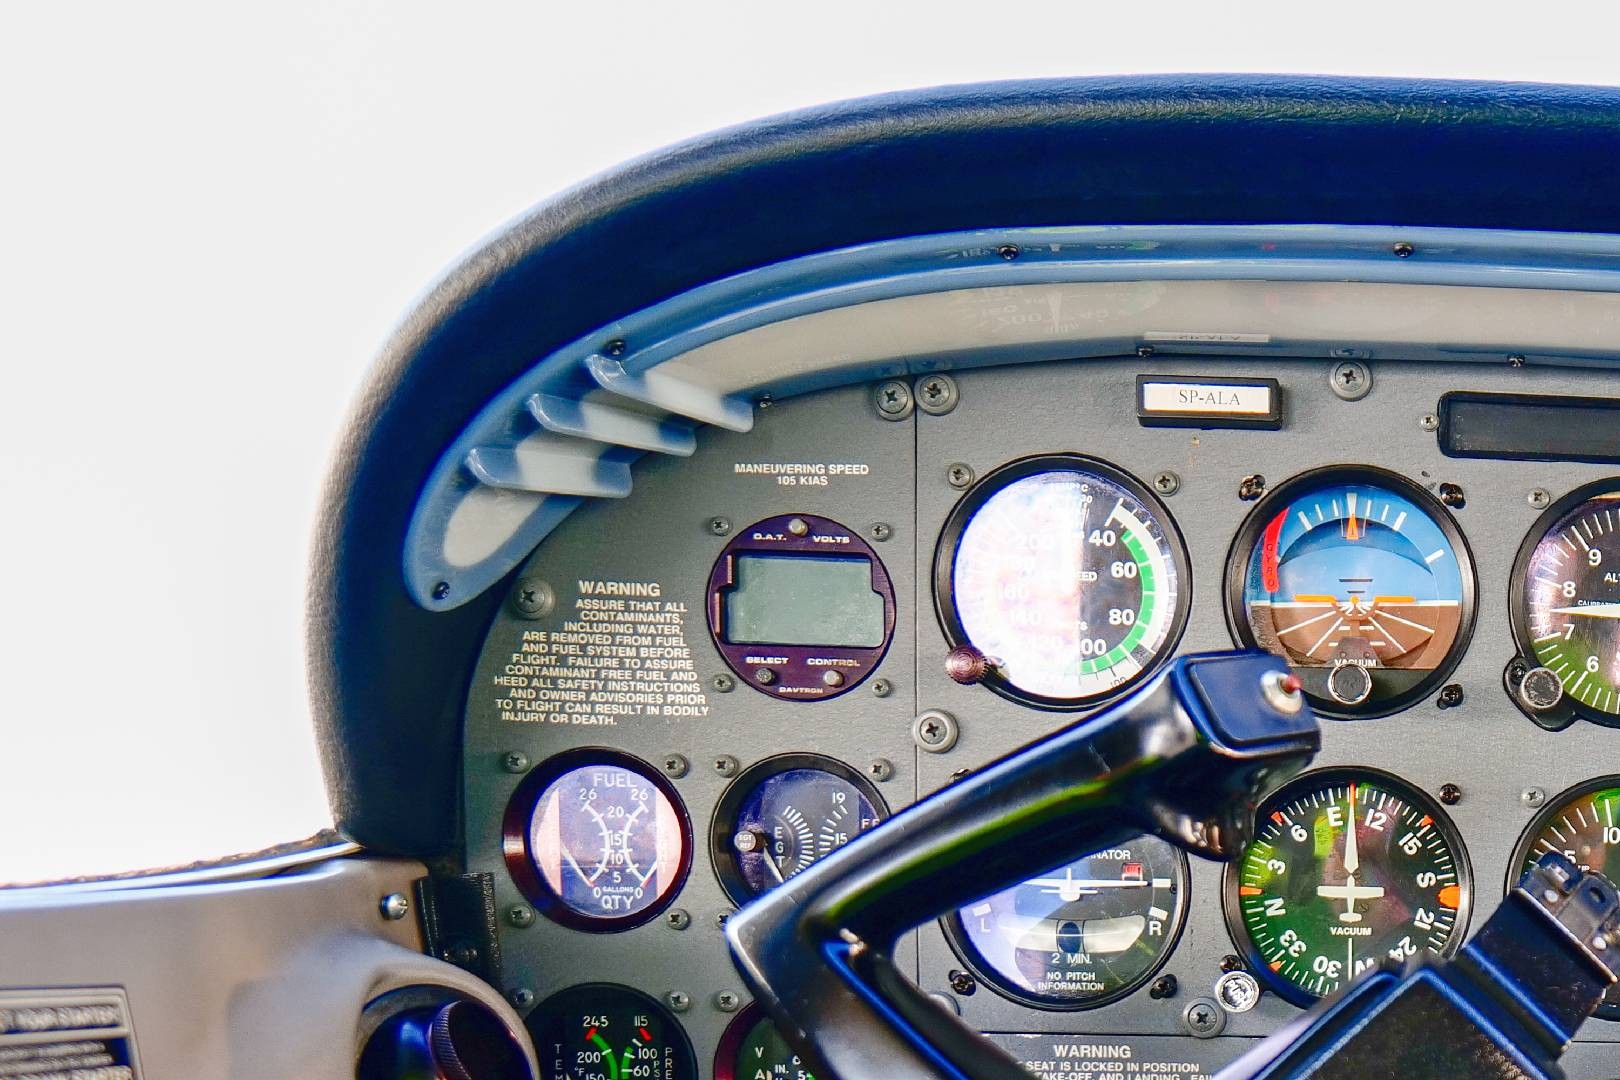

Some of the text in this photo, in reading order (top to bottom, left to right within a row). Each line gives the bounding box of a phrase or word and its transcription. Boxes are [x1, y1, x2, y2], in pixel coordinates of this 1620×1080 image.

[1178, 389, 1240, 405] SP-ALA
[734, 463, 869, 474] MANEUVERING SPEED
[776, 475, 828, 486] 105 KIAS
[1089, 530, 1116, 546] 40
[1111, 562, 1137, 578] 60
[579, 581, 660, 596] WARNING
[576, 600, 687, 612] ASSURE THAT ALL
[581, 611, 684, 624] CONTAMINANTS,
[1109, 609, 1134, 625] 80
[565, 622, 683, 636] INCLUDING WATER,
[523, 631, 647, 645] ARE REMOVED FROM
[807, 658, 860, 666] CONTROL
[593, 773, 636, 788] FUEL
[608, 807, 624, 818] 20
[602, 896, 633, 910] QTY
[1330, 927, 1372, 936] VACUUM
[1067, 954, 1092, 964] MIN.
[1047, 972, 1095, 981] NO PITCH
[1038, 982, 1104, 991] INFORMATION
[583, 1016, 608, 1027] 245
[577, 1051, 601, 1063] 200
[1054, 1045, 1131, 1057] WARNING
[1027, 1061, 1199, 1072] SEAT IS LOCKED IN POSITION
